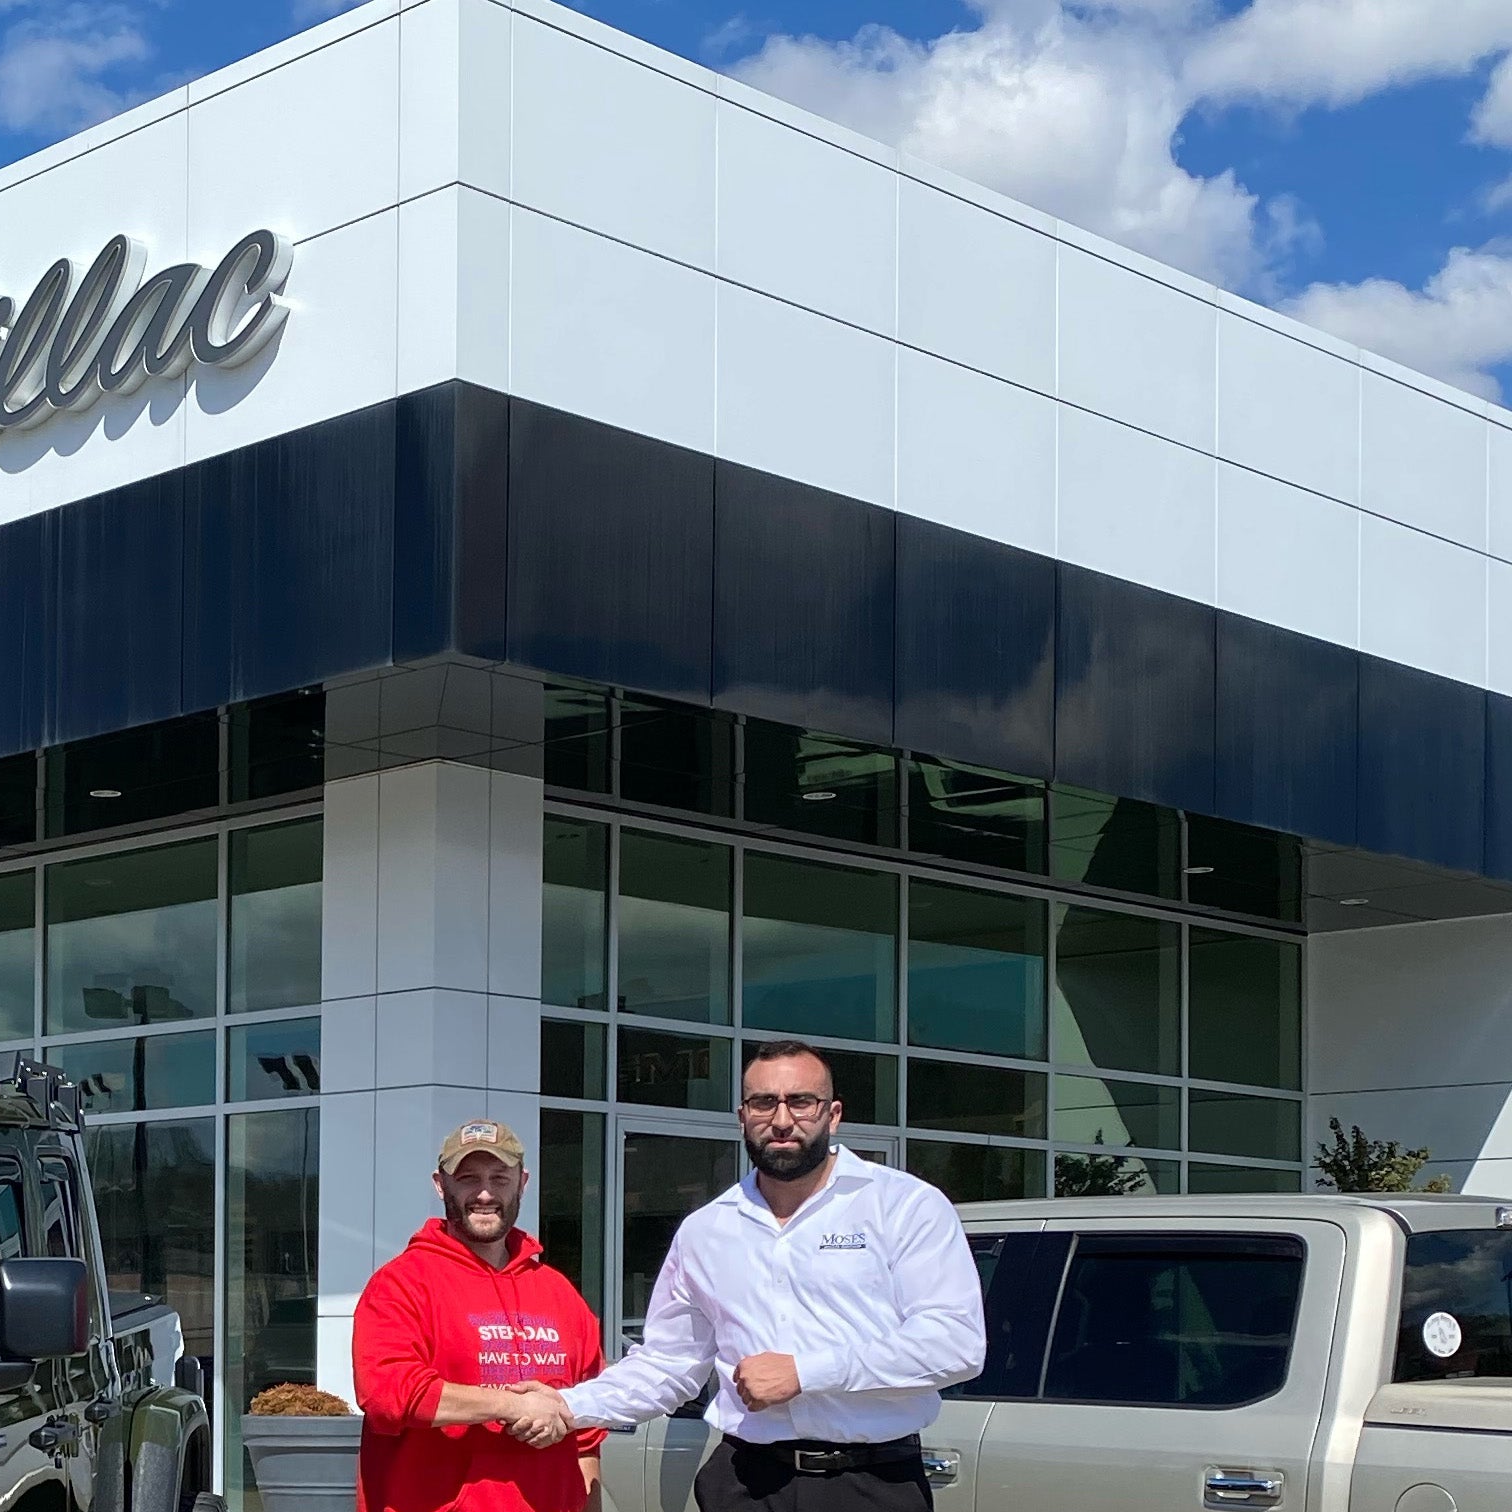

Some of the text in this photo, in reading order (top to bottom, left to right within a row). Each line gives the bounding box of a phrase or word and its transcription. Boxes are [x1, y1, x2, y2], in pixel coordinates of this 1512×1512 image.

[821, 1232, 866, 1245] MOSES
[478, 1351, 567, 1366] HAVE TO WAIT
